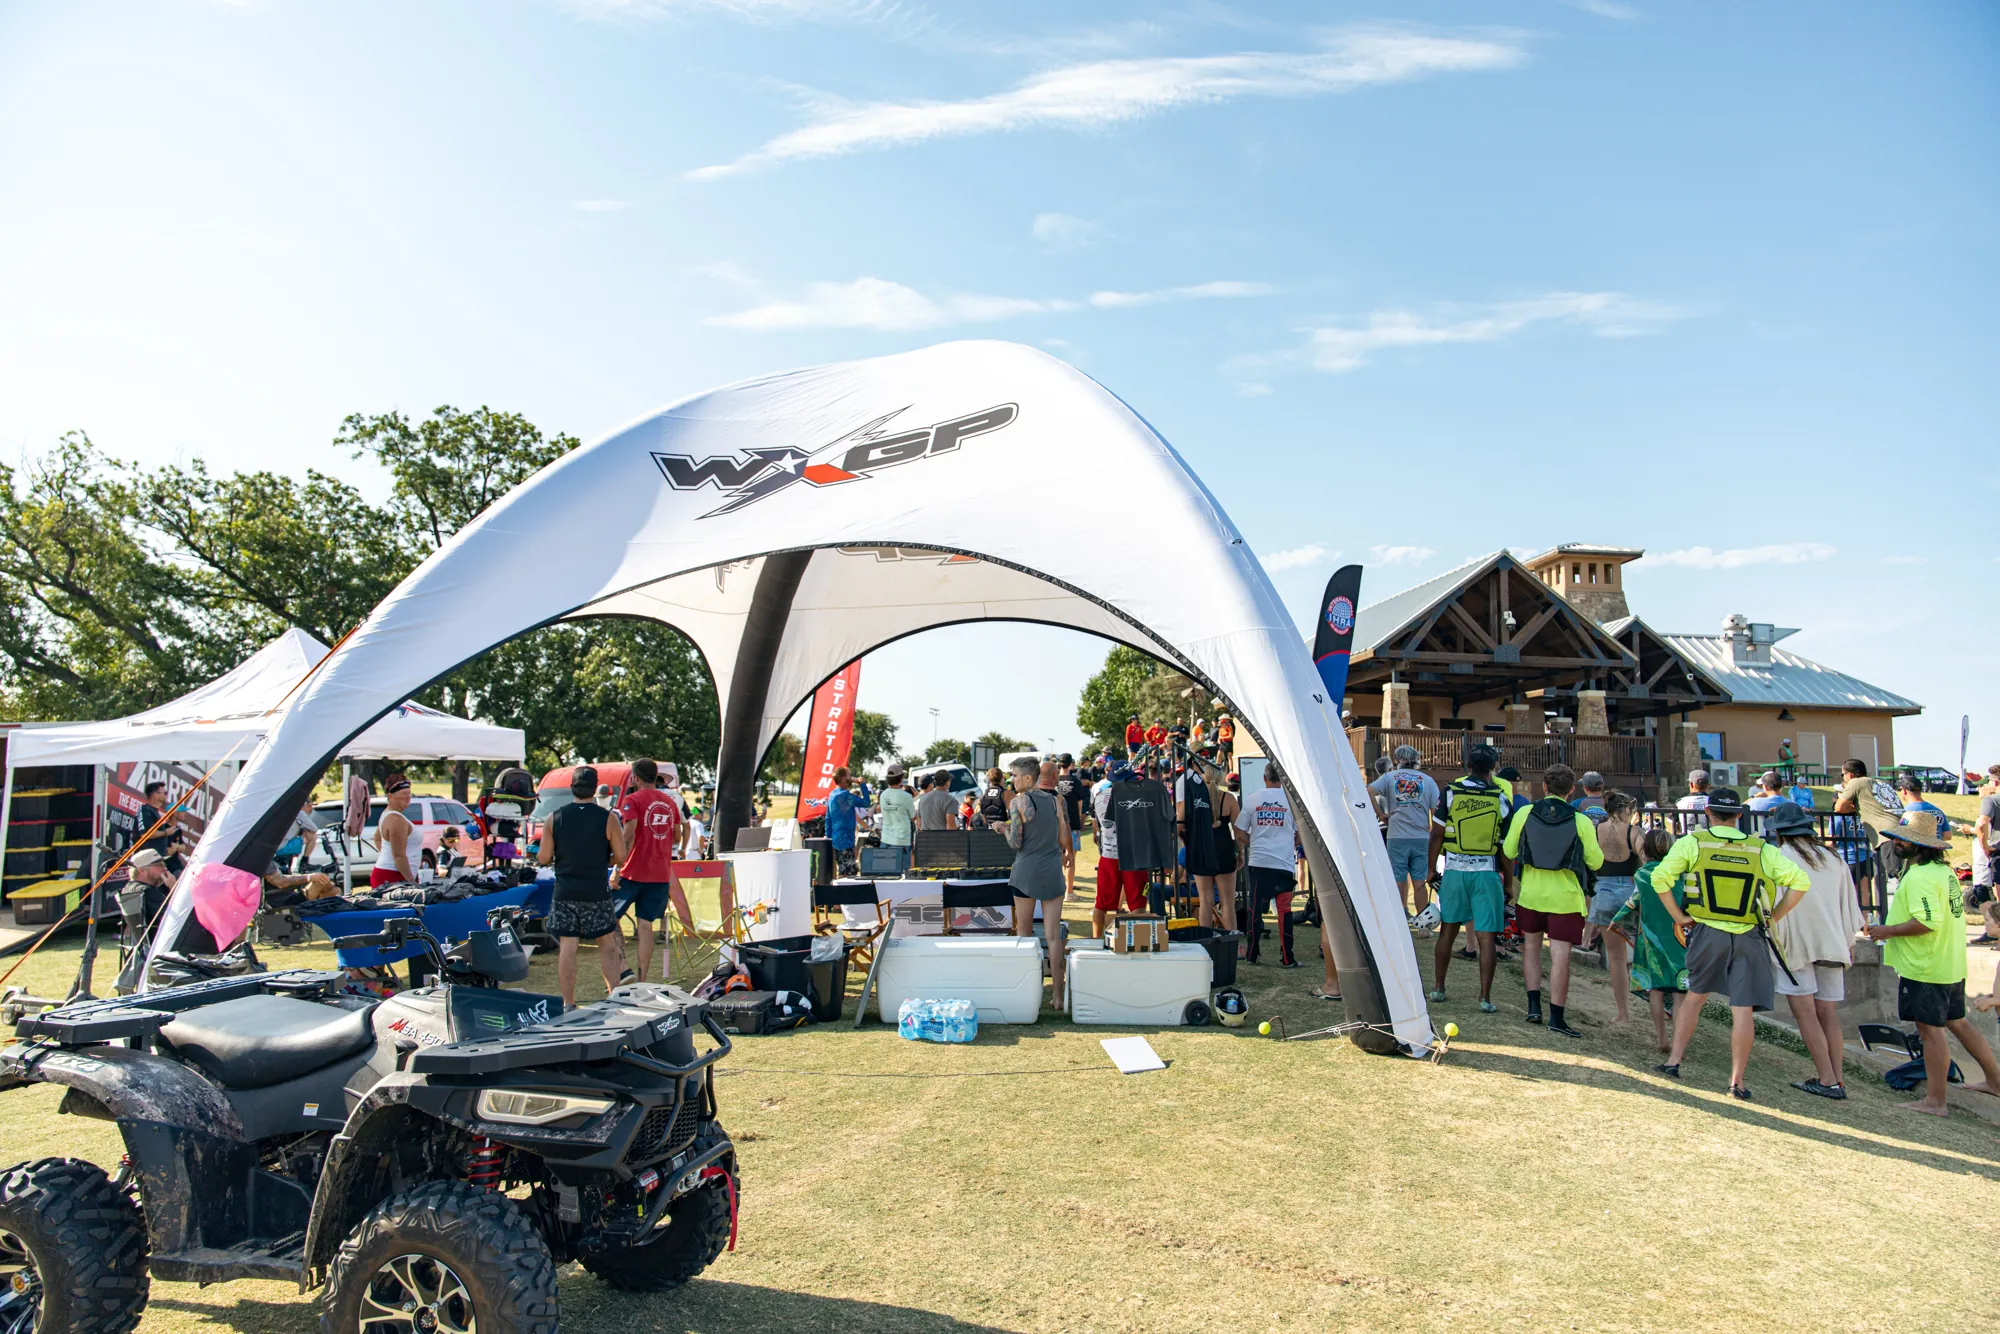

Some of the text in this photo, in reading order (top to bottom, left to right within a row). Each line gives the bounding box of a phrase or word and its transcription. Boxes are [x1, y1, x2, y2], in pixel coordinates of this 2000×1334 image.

[1329, 612, 1351, 628] IHRA
[118, 791, 130, 807] THE
[109, 810, 122, 826] AND
[1257, 811, 1284, 820] LIQUI
[1257, 819, 1284, 827] MOLY
[418, 1030, 446, 1046] 450
